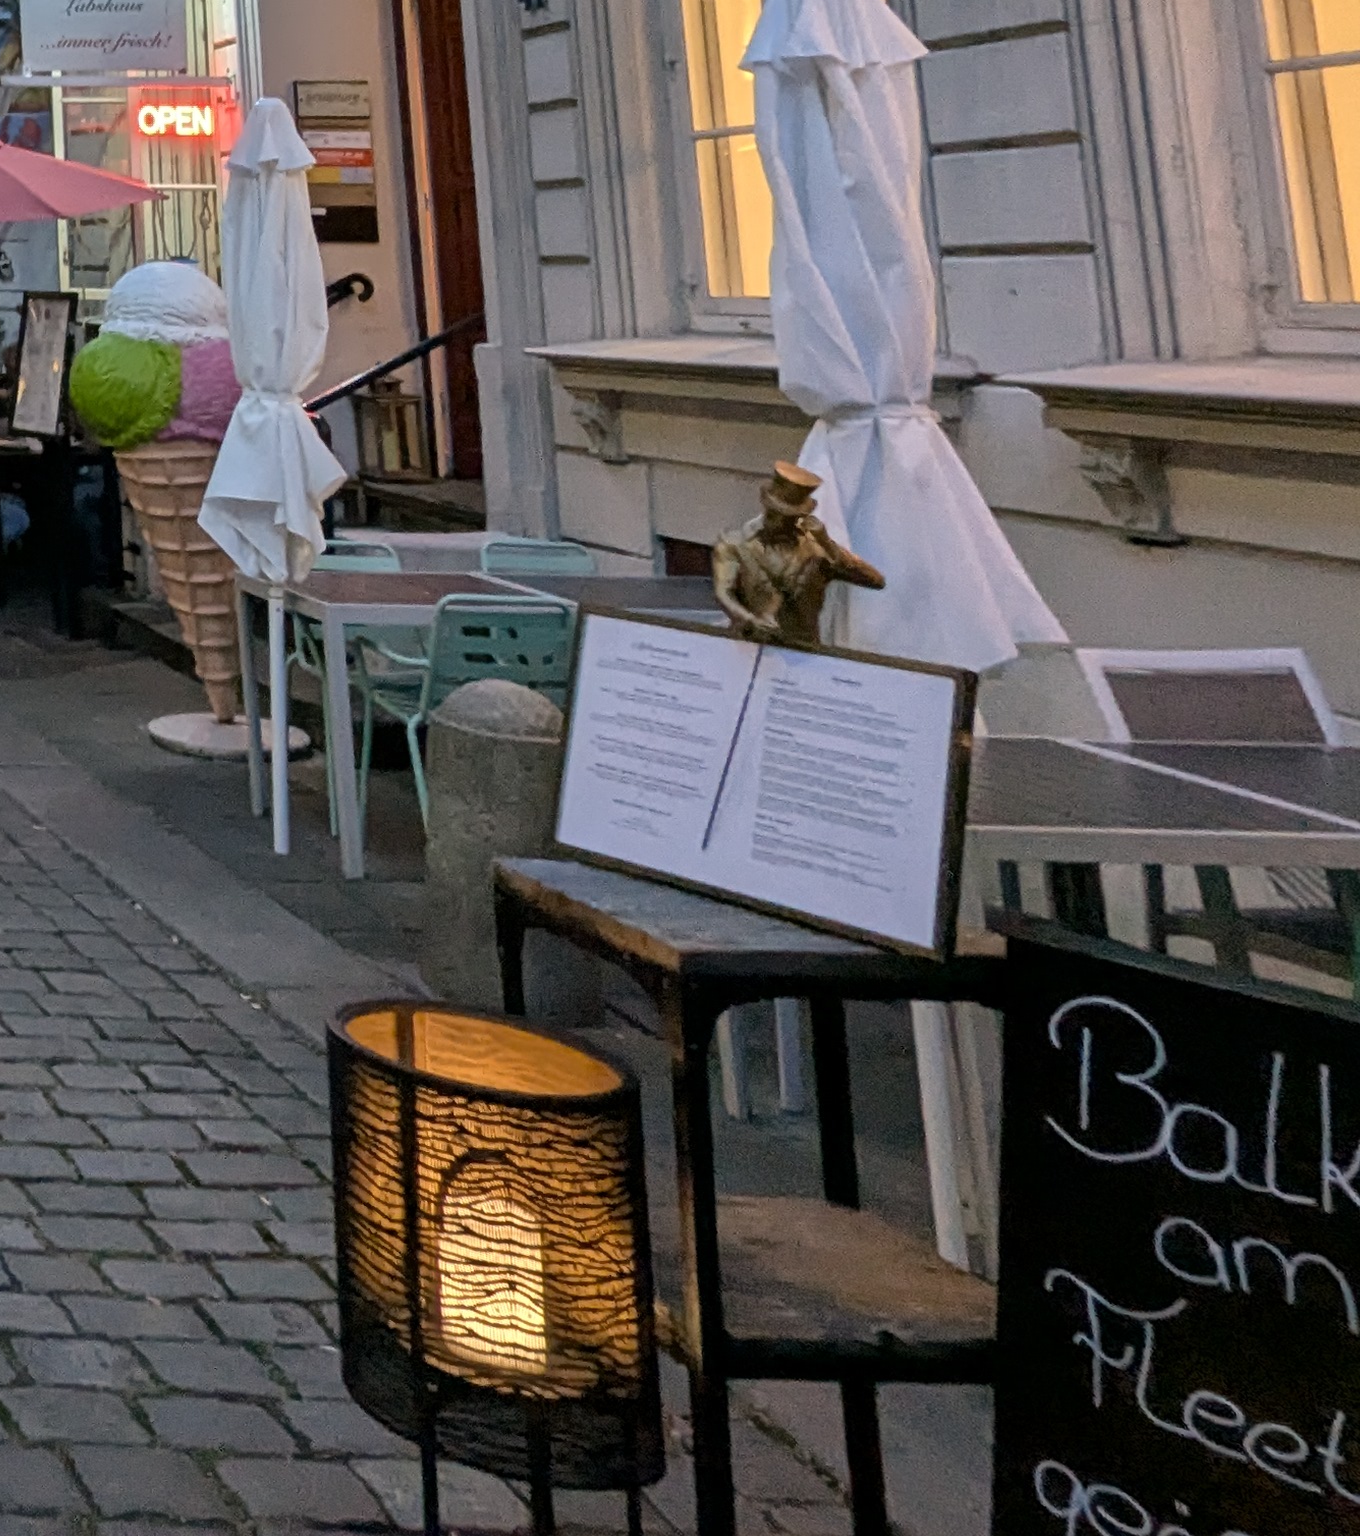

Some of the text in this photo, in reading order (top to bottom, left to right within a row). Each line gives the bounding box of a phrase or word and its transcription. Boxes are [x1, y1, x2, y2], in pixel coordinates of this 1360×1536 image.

[104, 31, 173, 54] frisch!
[138, 104, 215, 136] OPEN
[1154, 1217, 1360, 1336] am
[1043, 1268, 1360, 1505] Fleet
